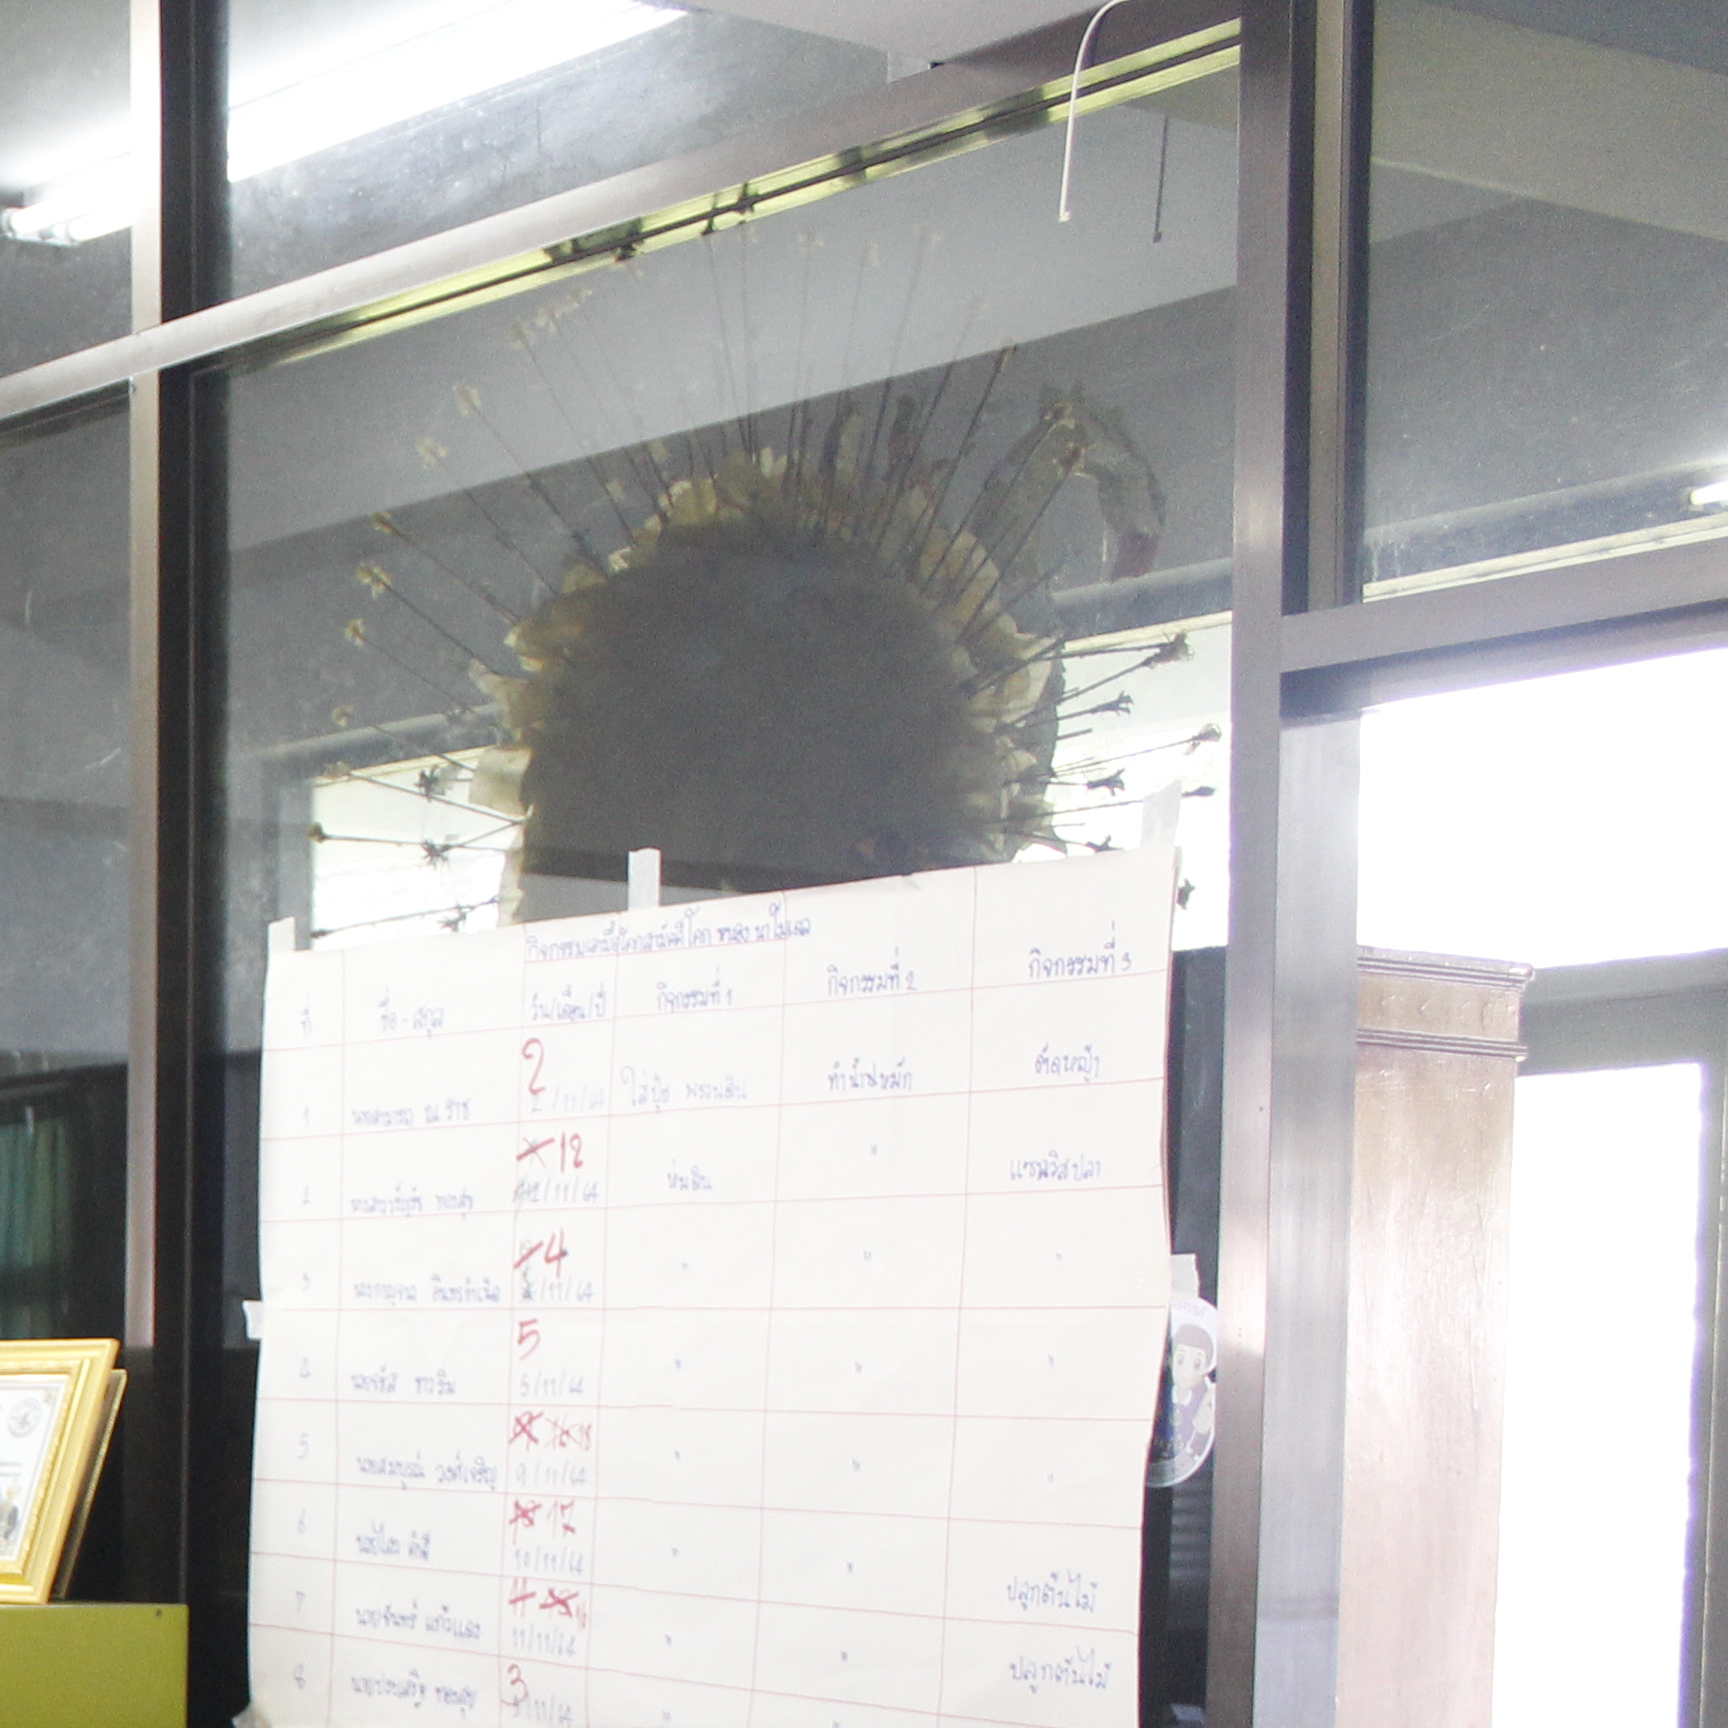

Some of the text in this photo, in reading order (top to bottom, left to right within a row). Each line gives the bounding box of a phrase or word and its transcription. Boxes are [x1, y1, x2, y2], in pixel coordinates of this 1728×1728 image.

[826, 945, 917, 996] กิจกรรมที่ 2
[1028, 919, 1133, 979] กิจกรรมที่ 3
[656, 965, 733, 1012] กิจกรรมที่ 1
[521, 1037, 546, 1095] 2
[543, 1227, 569, 1279] 4
[517, 1317, 541, 1361] 5
[1006, 1567, 1099, 1613] ปลูกต้นไม้
[501, 1663, 530, 1707] 3
[1009, 1644, 1112, 1694] ปลูกต้นไม้
